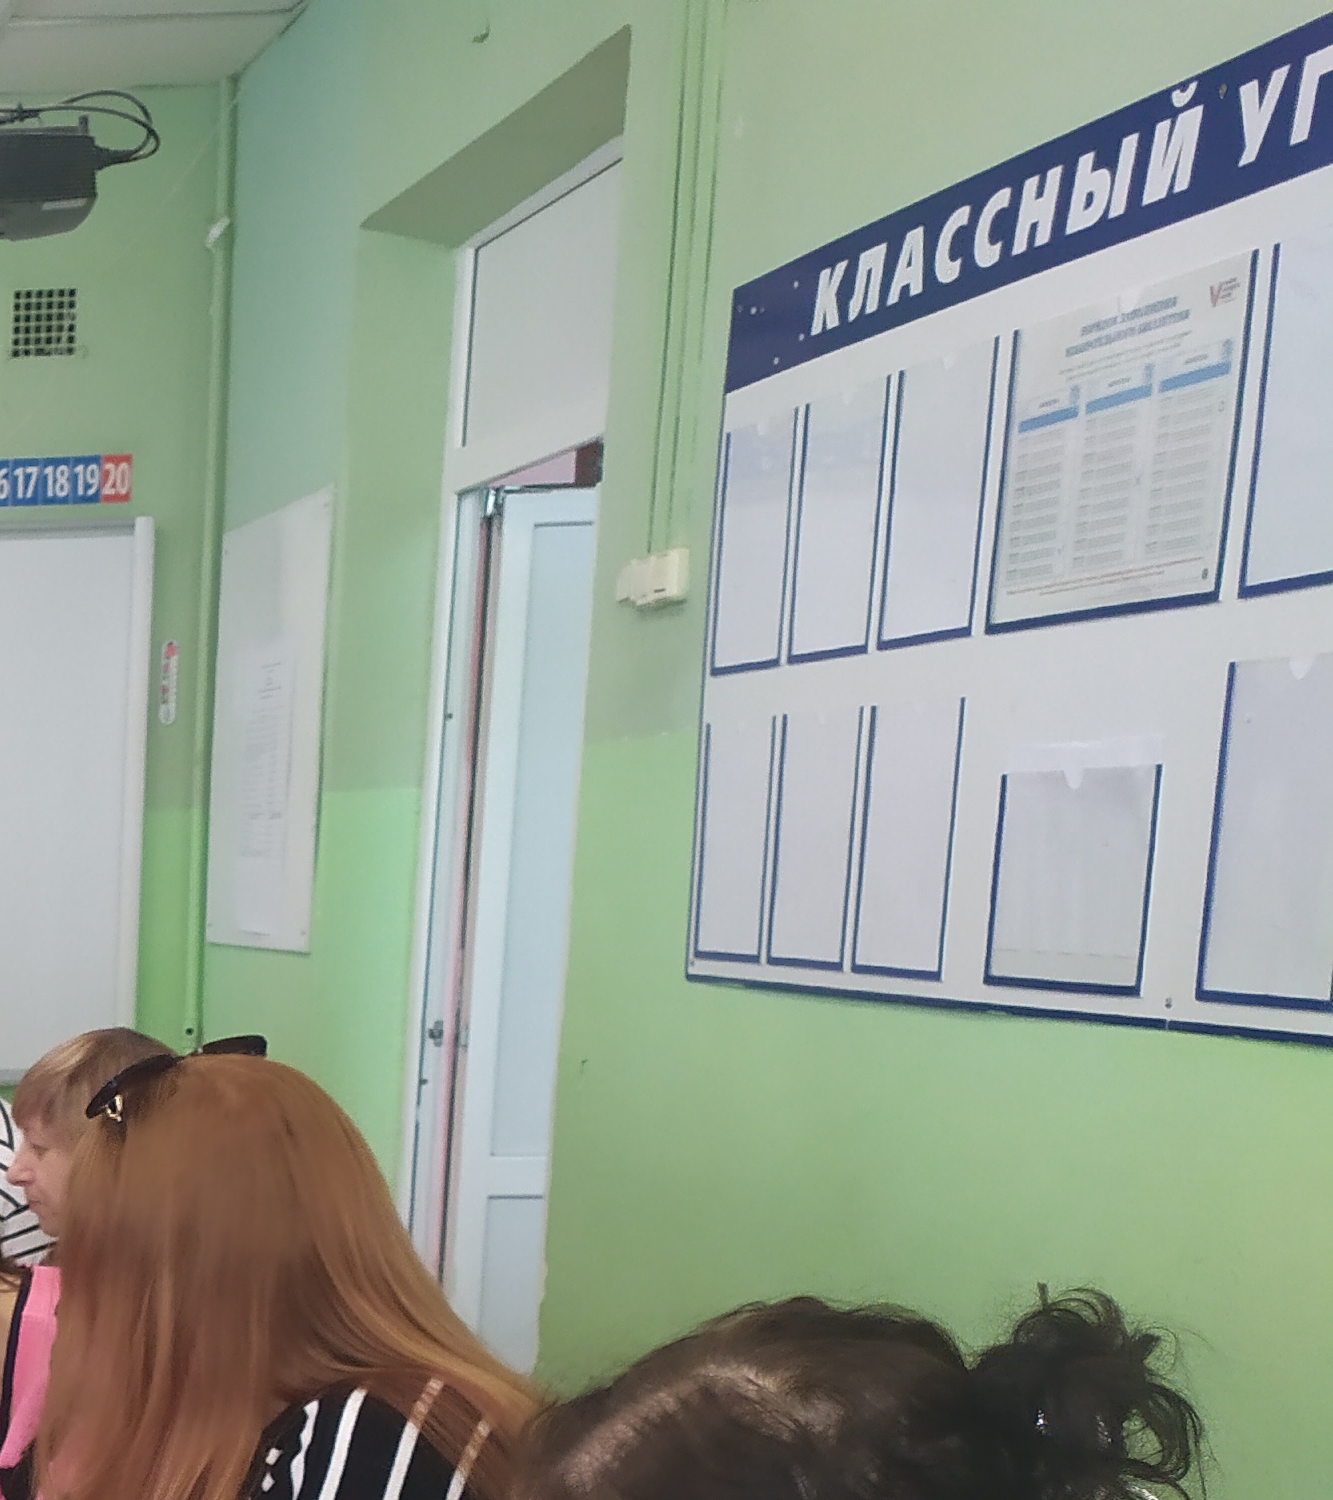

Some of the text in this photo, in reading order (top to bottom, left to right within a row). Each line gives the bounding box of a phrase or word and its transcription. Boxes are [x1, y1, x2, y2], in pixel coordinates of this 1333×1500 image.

[810, 81, 1204, 337] КЛАССНЫЙ
[14, 466, 38, 499] 17
[44, 464, 69, 497] 18
[74, 463, 100, 496] 19
[102, 462, 129, 495] 20
